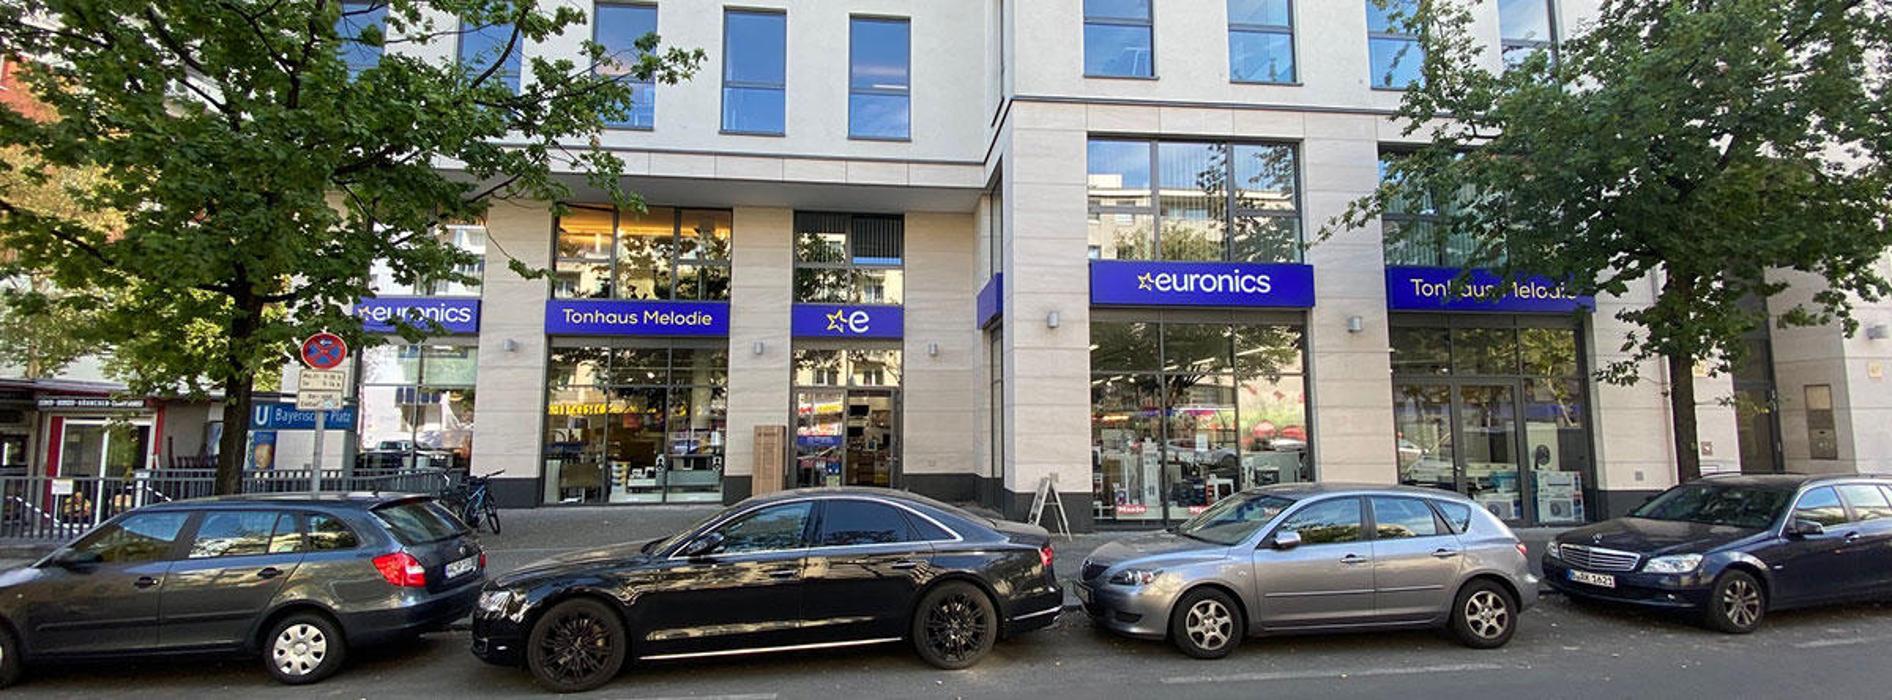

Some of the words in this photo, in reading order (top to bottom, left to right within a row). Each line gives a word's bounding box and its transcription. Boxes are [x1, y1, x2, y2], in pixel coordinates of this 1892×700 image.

[1155, 269, 1271, 293] euronics
[562, 308, 638, 325] Tonhaus
[643, 310, 713, 325] Melodie
[849, 310, 869, 333] e
[254, 405, 269, 425] U
